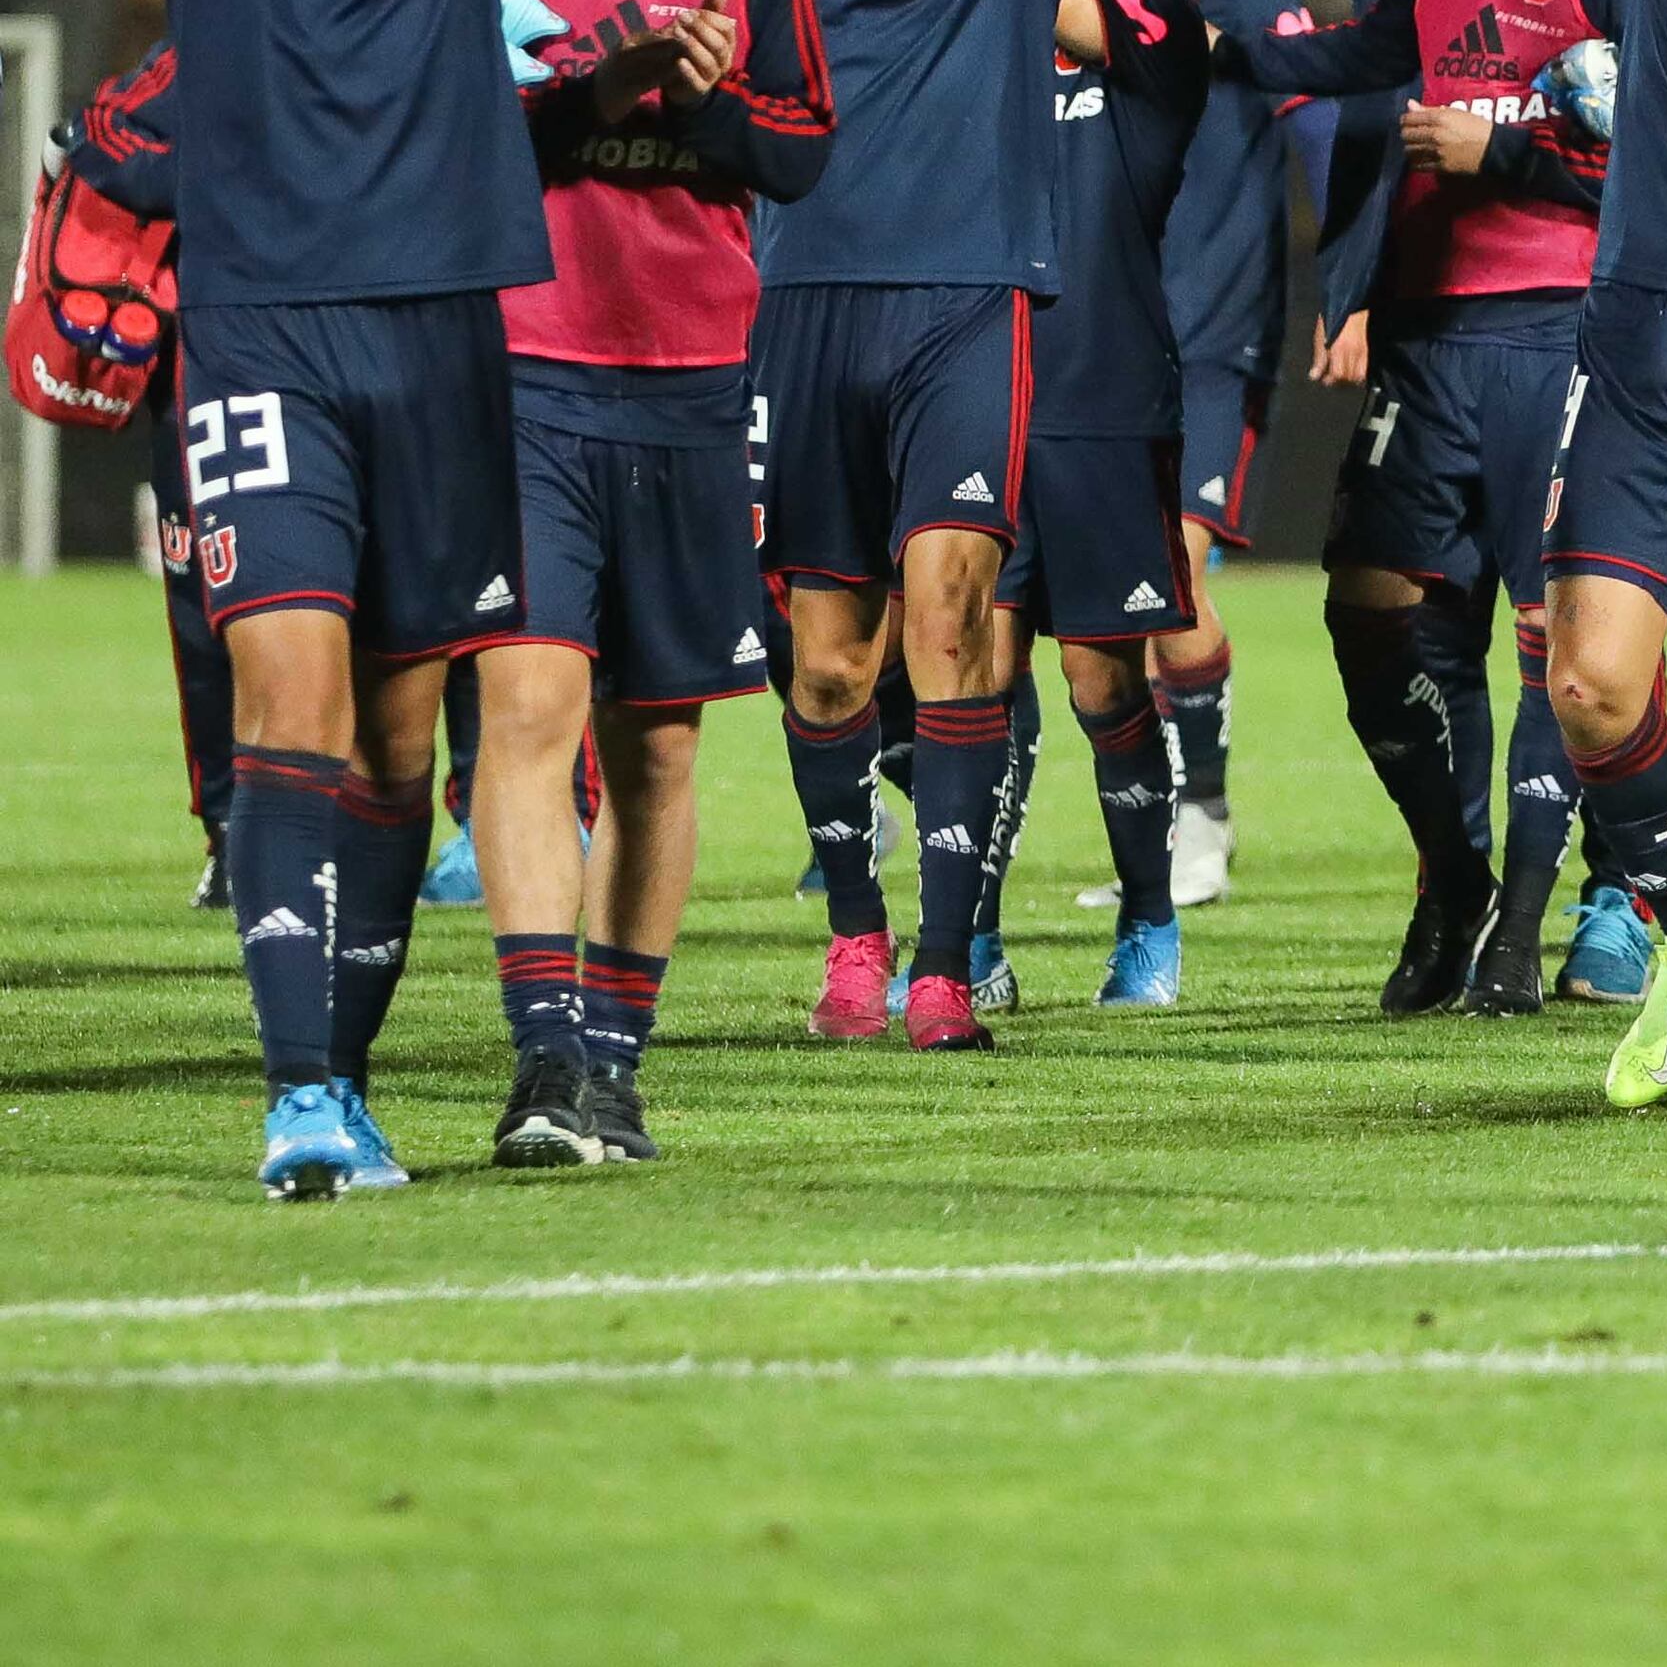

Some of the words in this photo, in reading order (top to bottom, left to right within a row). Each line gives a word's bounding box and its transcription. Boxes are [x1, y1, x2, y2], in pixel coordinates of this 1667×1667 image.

[1433, 50, 1521, 82] adidas
[186, 391, 290, 506] 23
[952, 487, 995, 504] adidas
[1123, 596, 1167, 614] adidas
